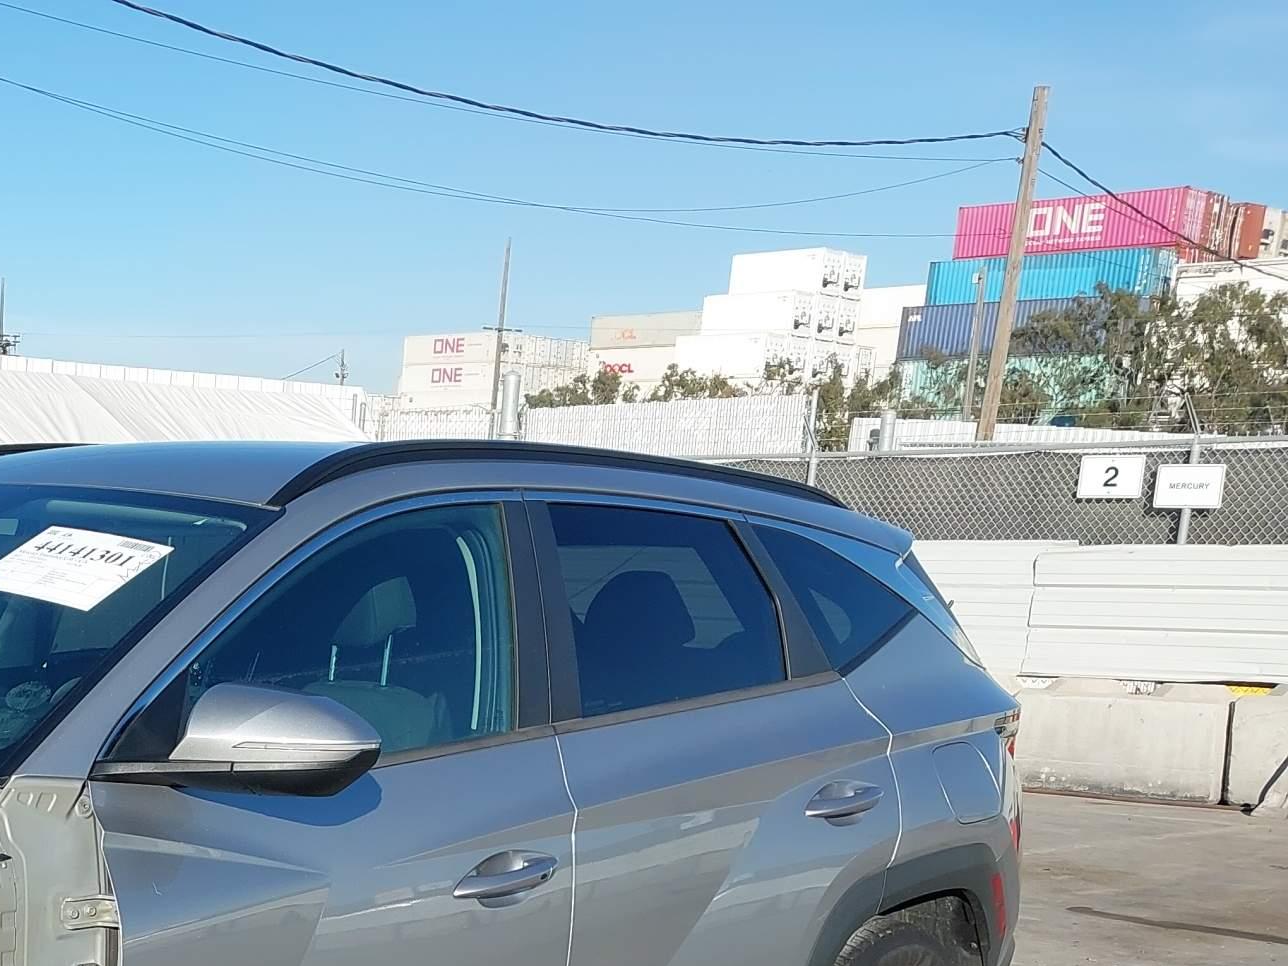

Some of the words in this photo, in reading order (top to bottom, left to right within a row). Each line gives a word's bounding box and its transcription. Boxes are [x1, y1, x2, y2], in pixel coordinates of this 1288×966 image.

[1026, 203, 1106, 237] ONE
[433, 338, 465, 354] ONE
[431, 367, 463, 384] ONE
[1103, 466, 1119, 488] 2
[1168, 482, 1211, 490] MERCURY
[34, 540, 136, 567] 44141301
